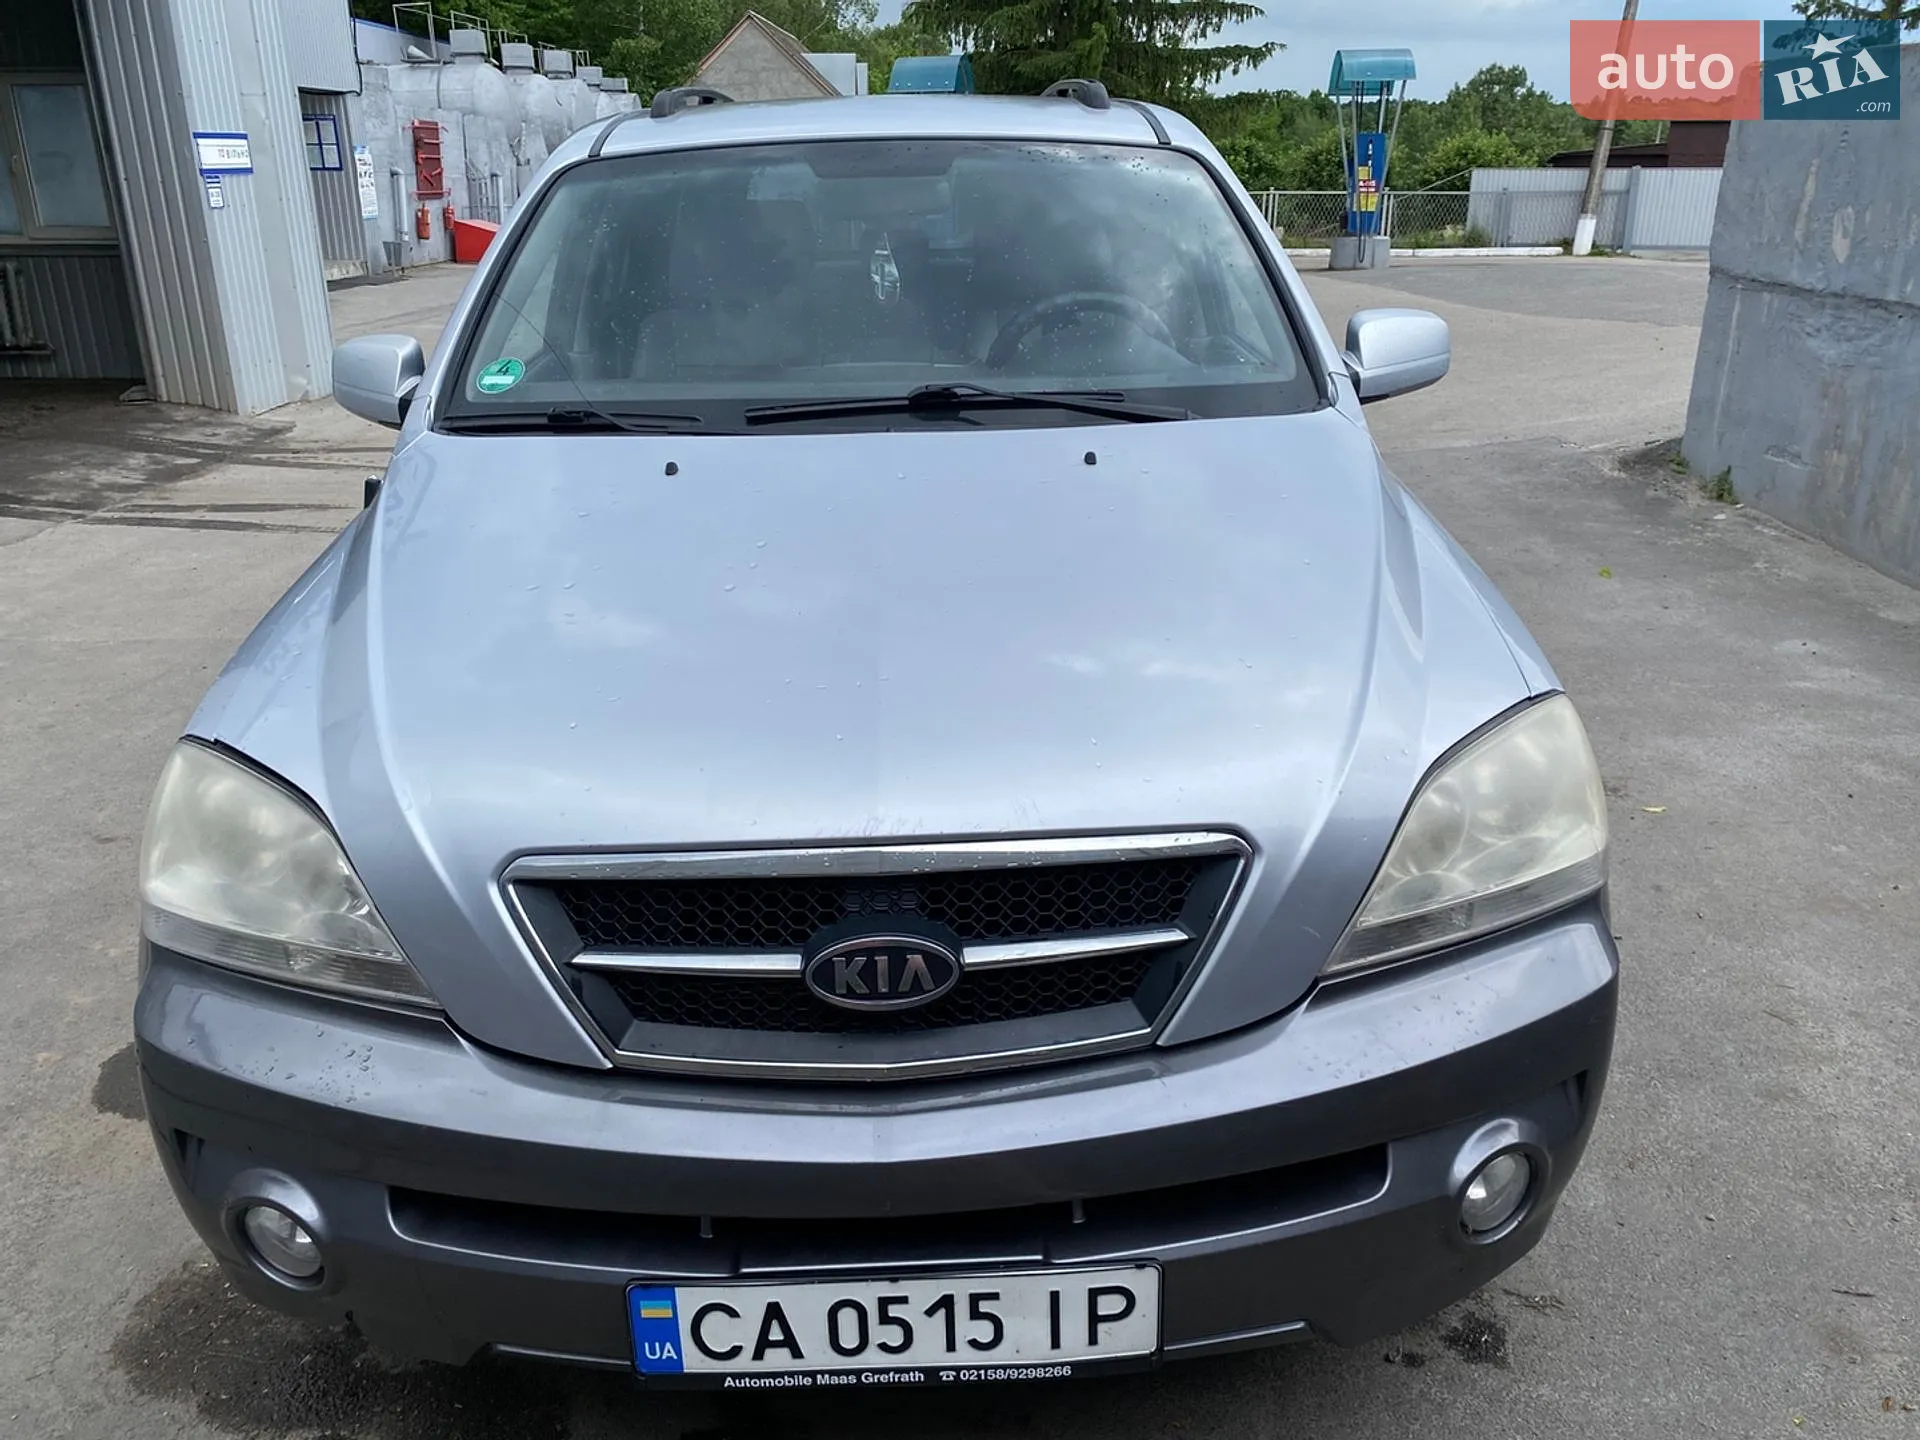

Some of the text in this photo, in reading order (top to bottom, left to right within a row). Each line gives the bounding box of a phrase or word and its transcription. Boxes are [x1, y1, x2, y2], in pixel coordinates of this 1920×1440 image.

[497, 359, 512, 375] 4
[831, 954, 936, 995] KIA
[690, 1285, 1137, 1362] CA 0515 IP
[644, 1341, 678, 1360] UA
[723, 1365, 1073, 1388] Automobile Maas Grefrath 02158/9298266
